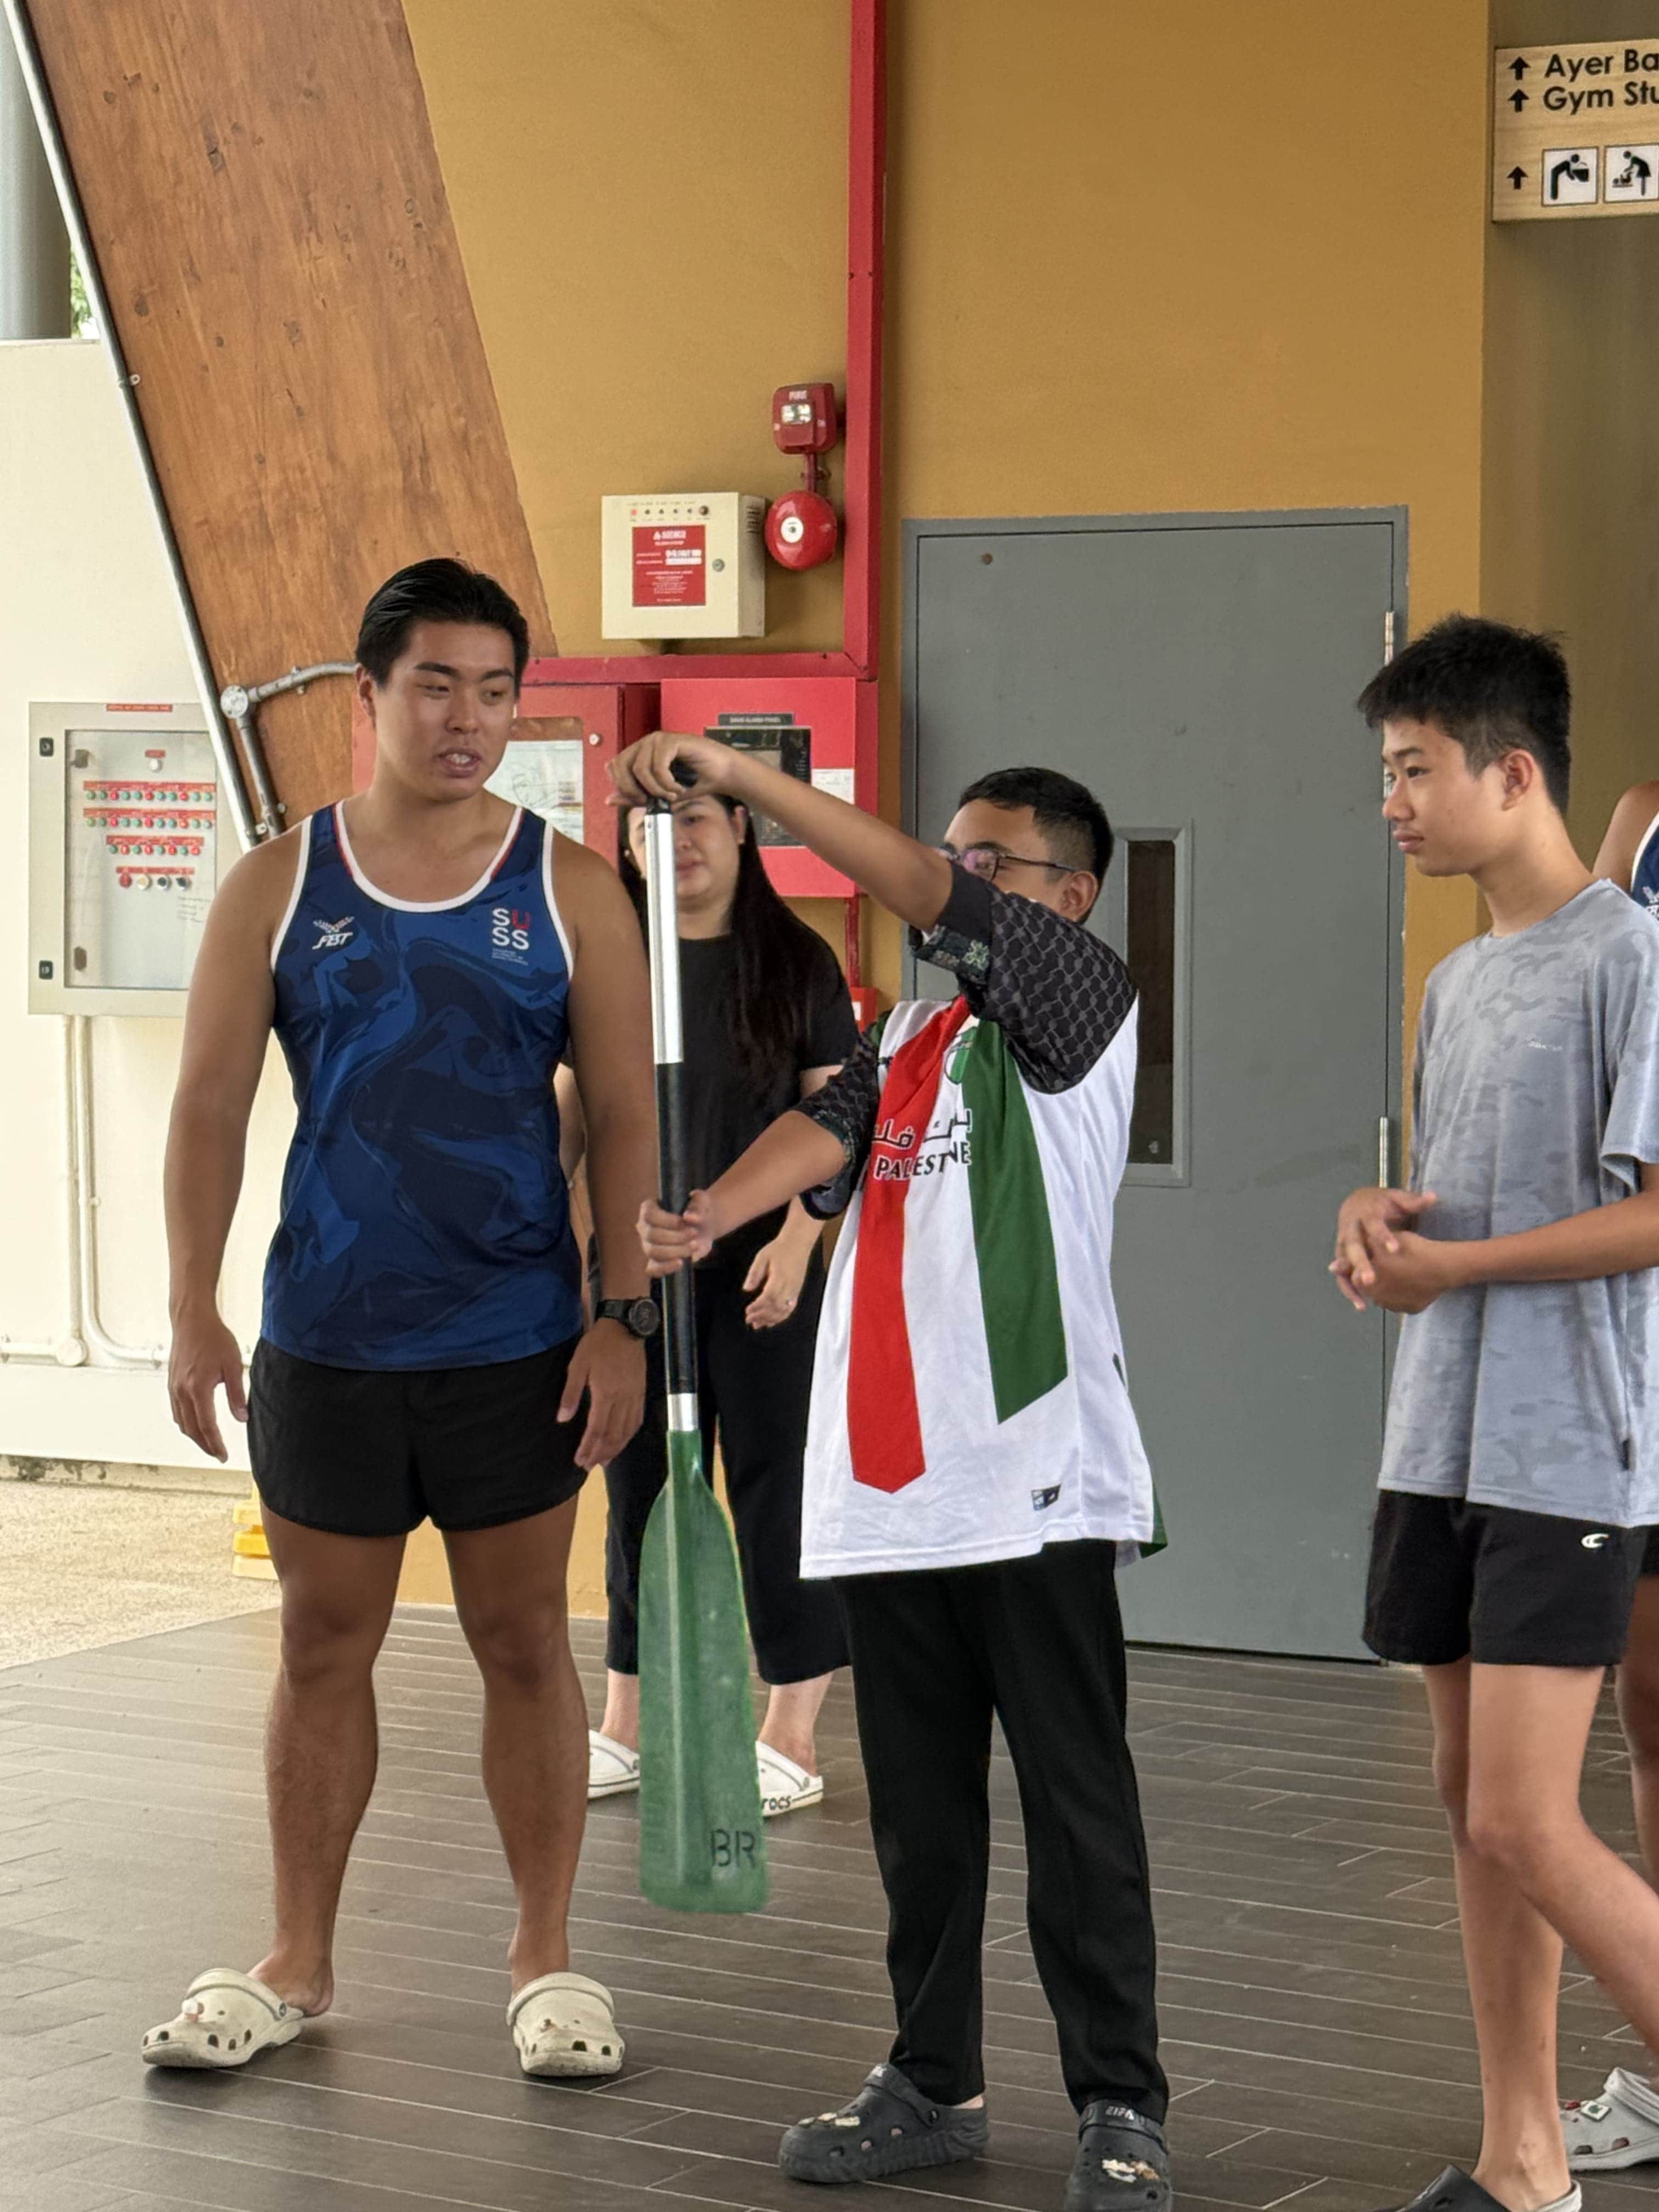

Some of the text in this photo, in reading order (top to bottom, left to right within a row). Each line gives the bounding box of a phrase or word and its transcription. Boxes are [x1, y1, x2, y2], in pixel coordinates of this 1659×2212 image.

[1544, 54, 1613, 82] Ayer
[1543, 86, 1613, 115] Gym
[874, 1141, 972, 1179] PALESTNE
[761, 1796, 791, 1810] rocs
[711, 1829, 757, 1868] BR
